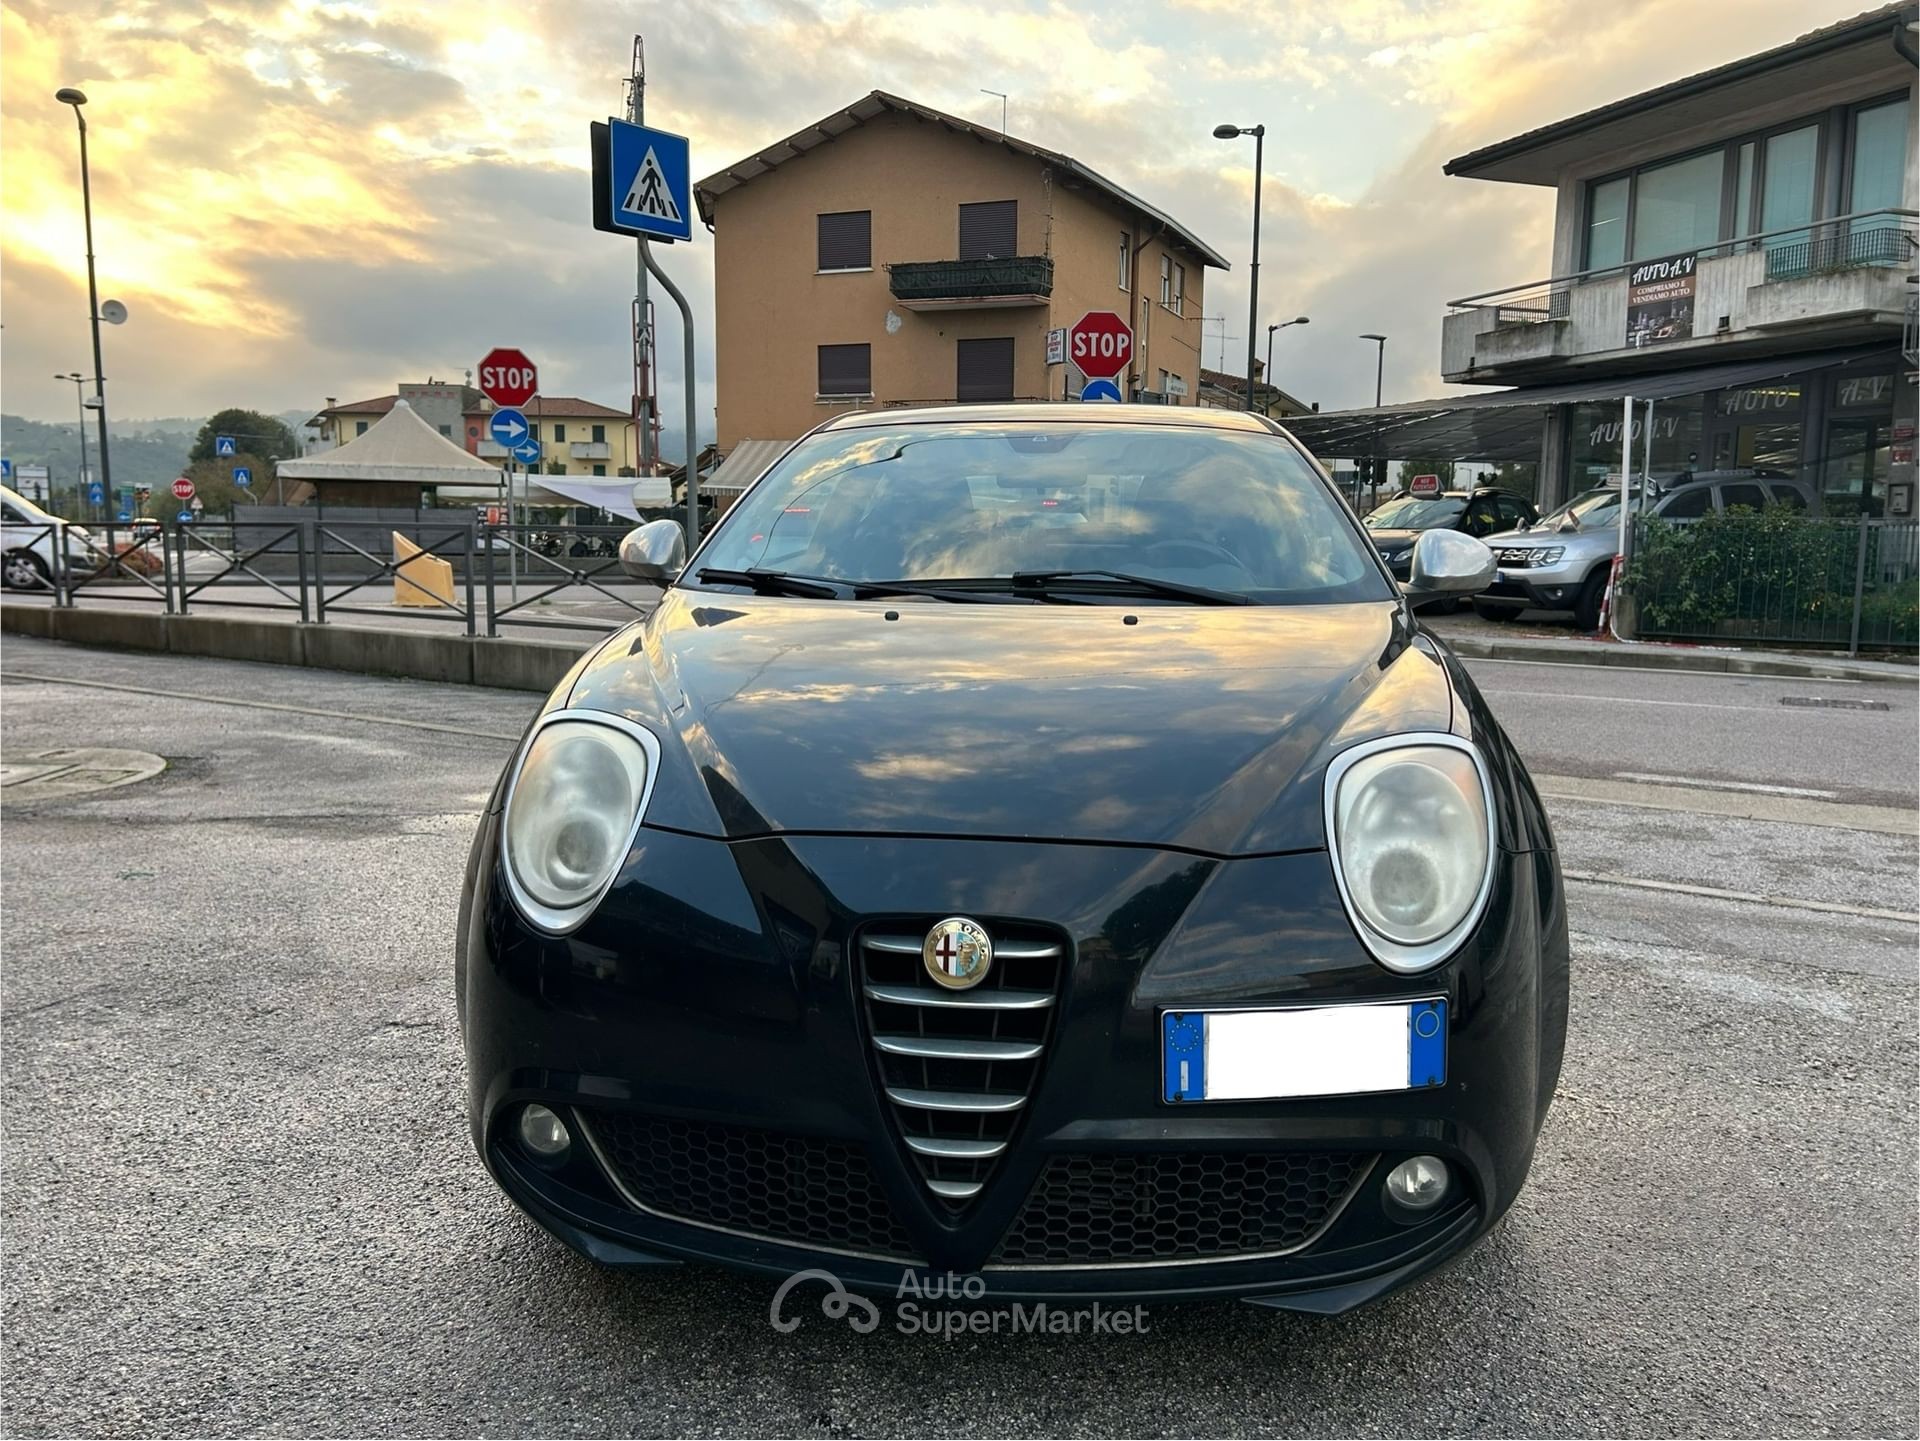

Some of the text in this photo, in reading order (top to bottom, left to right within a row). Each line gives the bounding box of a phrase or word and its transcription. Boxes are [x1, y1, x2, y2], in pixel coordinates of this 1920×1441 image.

[1632, 262, 1670, 285] AUTO
[1632, 287, 1690, 304] VENDIAMO AUTO
[1637, 280, 1686, 295] COMPRIAMO E
[1074, 332, 1129, 357] STOP
[483, 367, 534, 390] STOP
[1725, 385, 1790, 415] AUTO
[174, 485, 193, 493] STOP
